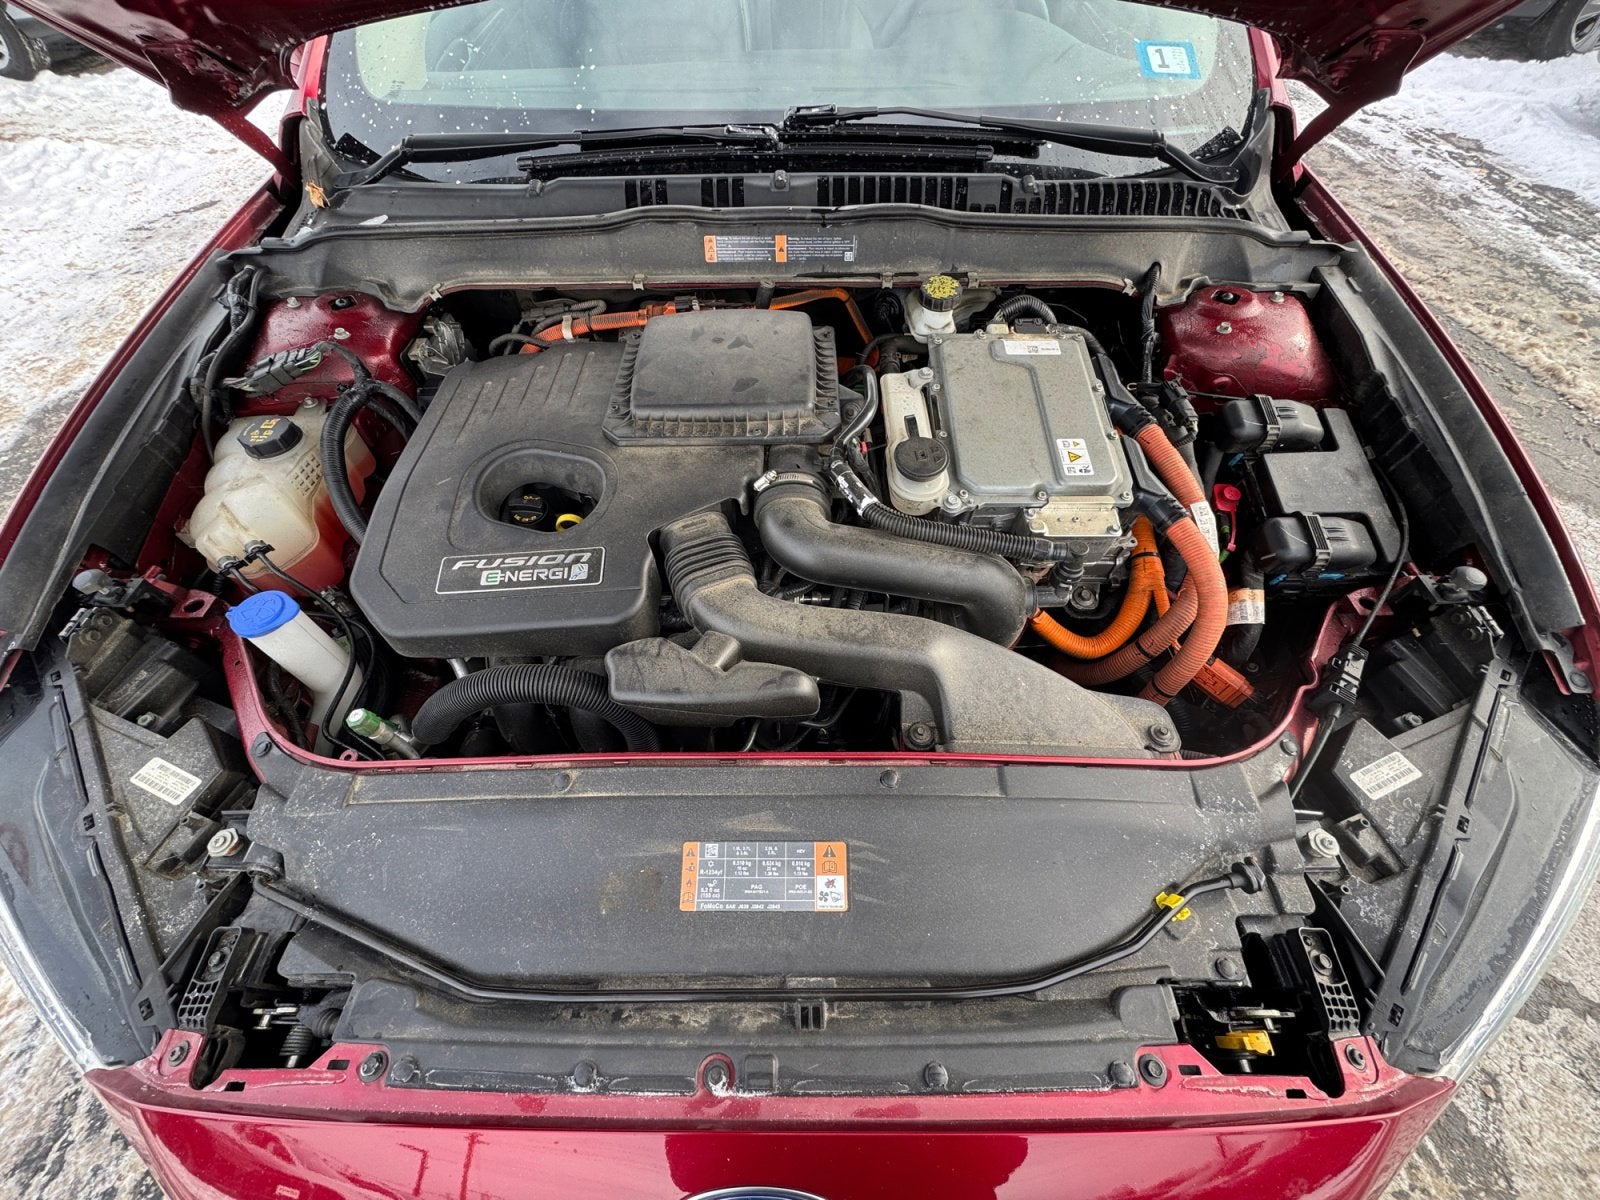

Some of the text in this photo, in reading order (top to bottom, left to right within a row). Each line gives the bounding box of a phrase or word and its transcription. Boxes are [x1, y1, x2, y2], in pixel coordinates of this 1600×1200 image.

[1155, 48, 1170, 68] 1
[451, 552, 592, 570] FUSION
[482, 567, 569, 586] ENERGI
